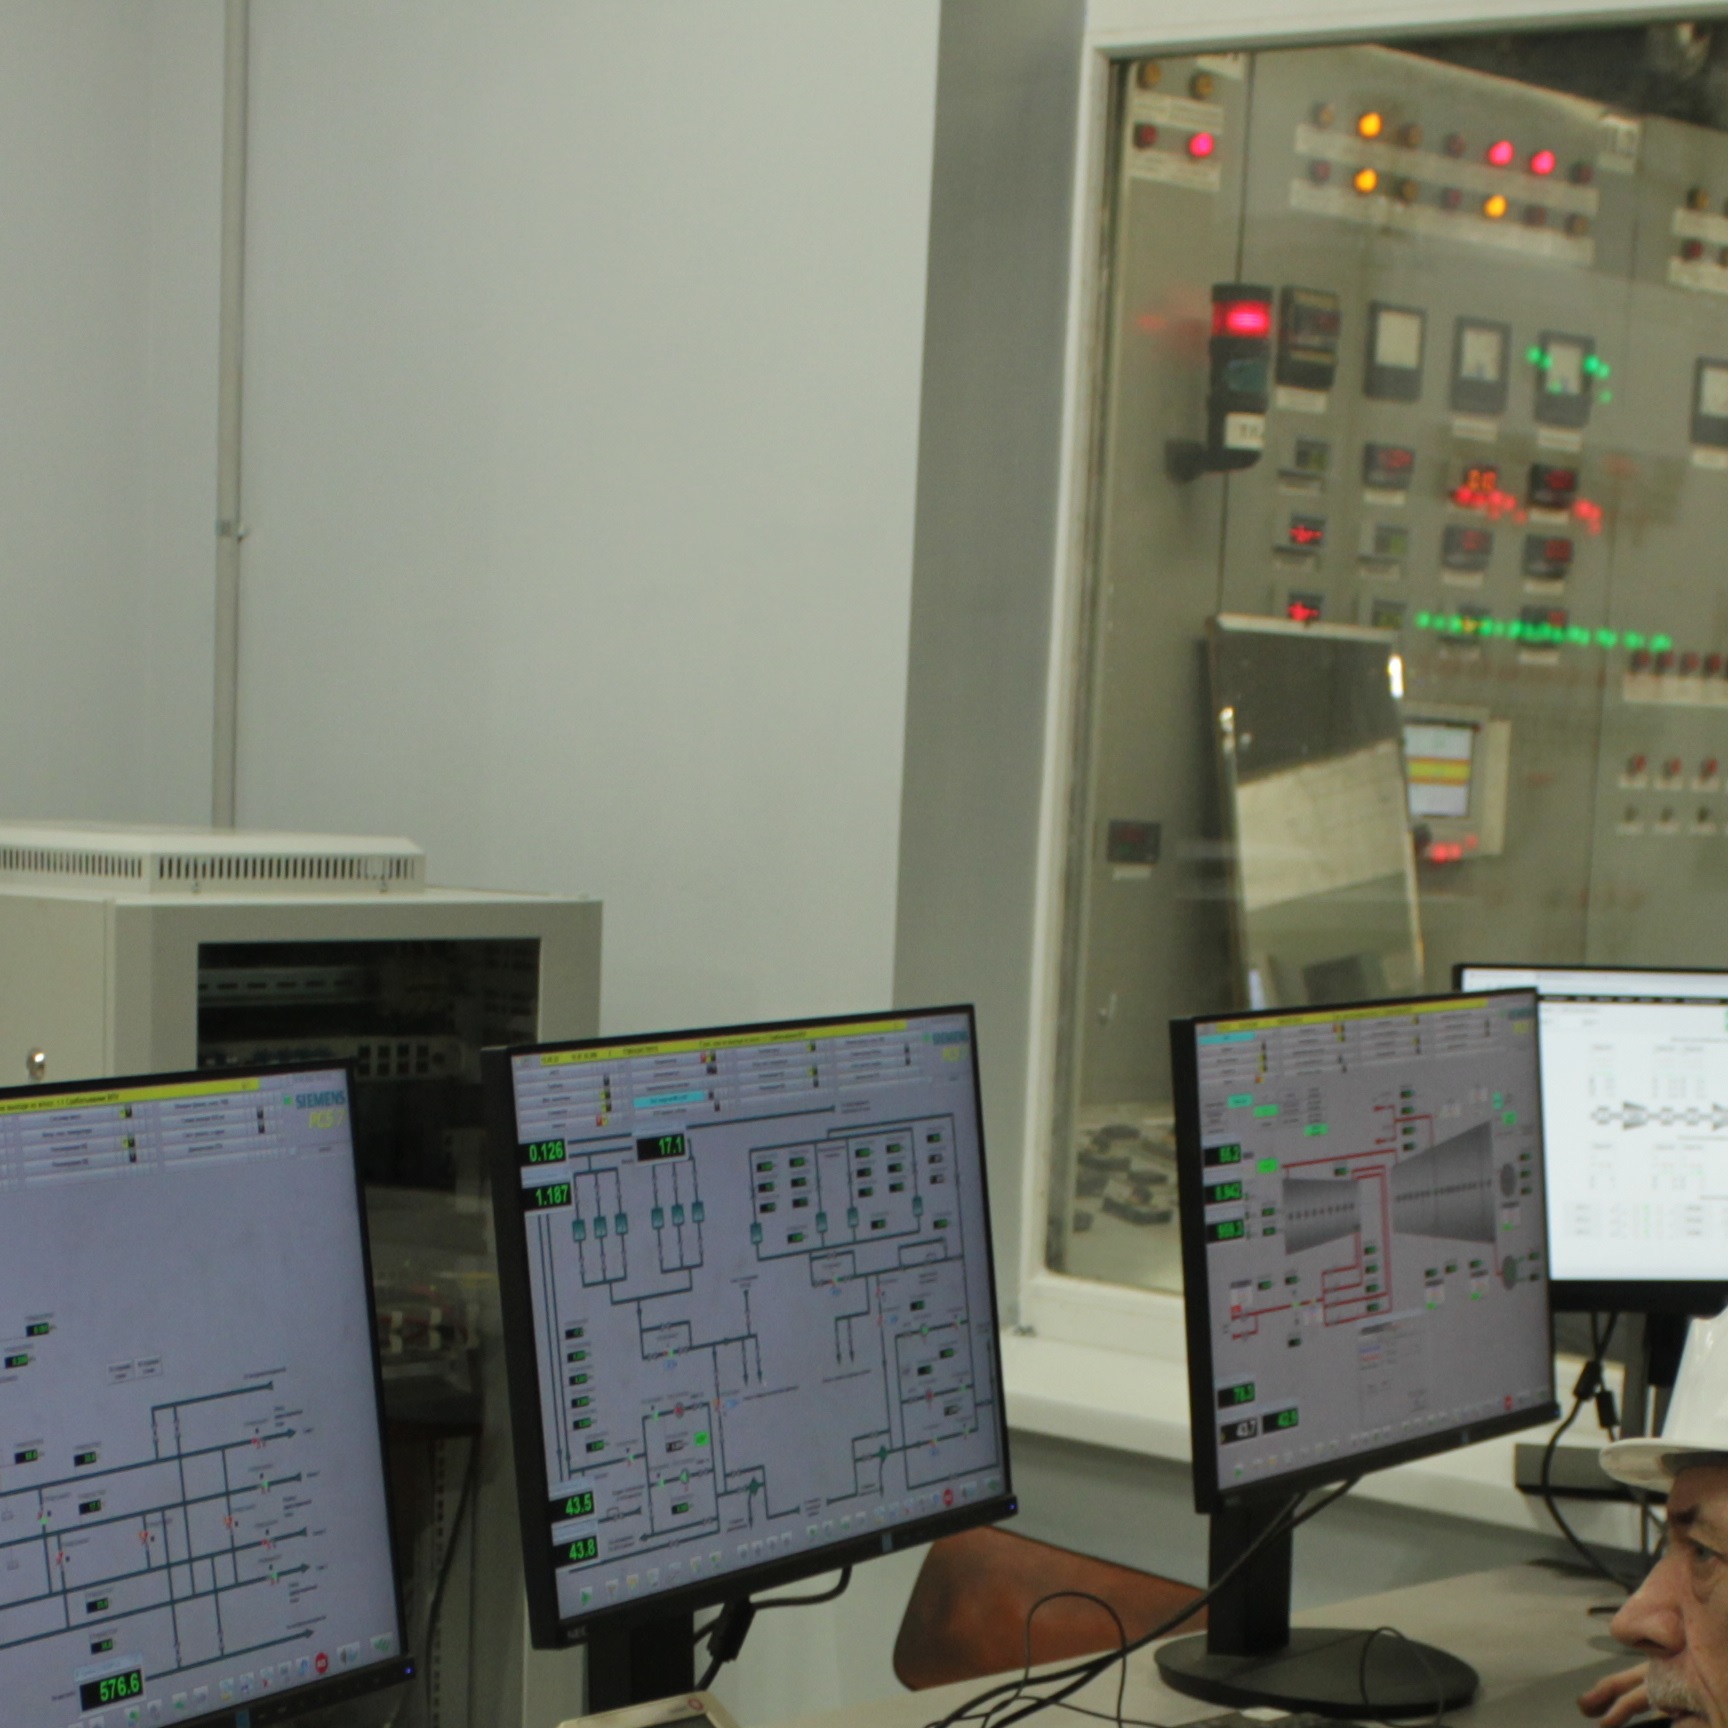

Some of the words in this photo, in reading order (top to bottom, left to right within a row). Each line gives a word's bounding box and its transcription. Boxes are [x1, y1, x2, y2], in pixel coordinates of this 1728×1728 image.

[295, 1089, 347, 1110] SIEMENS
[528, 1140, 564, 1163] 0.126
[658, 1135, 684, 1156] 17.1
[535, 1183, 569, 1207] 1.187
[565, 1493, 593, 1516] 43.5
[569, 1538, 596, 1561] 43.8
[99, 1671, 140, 1703] 576.6
